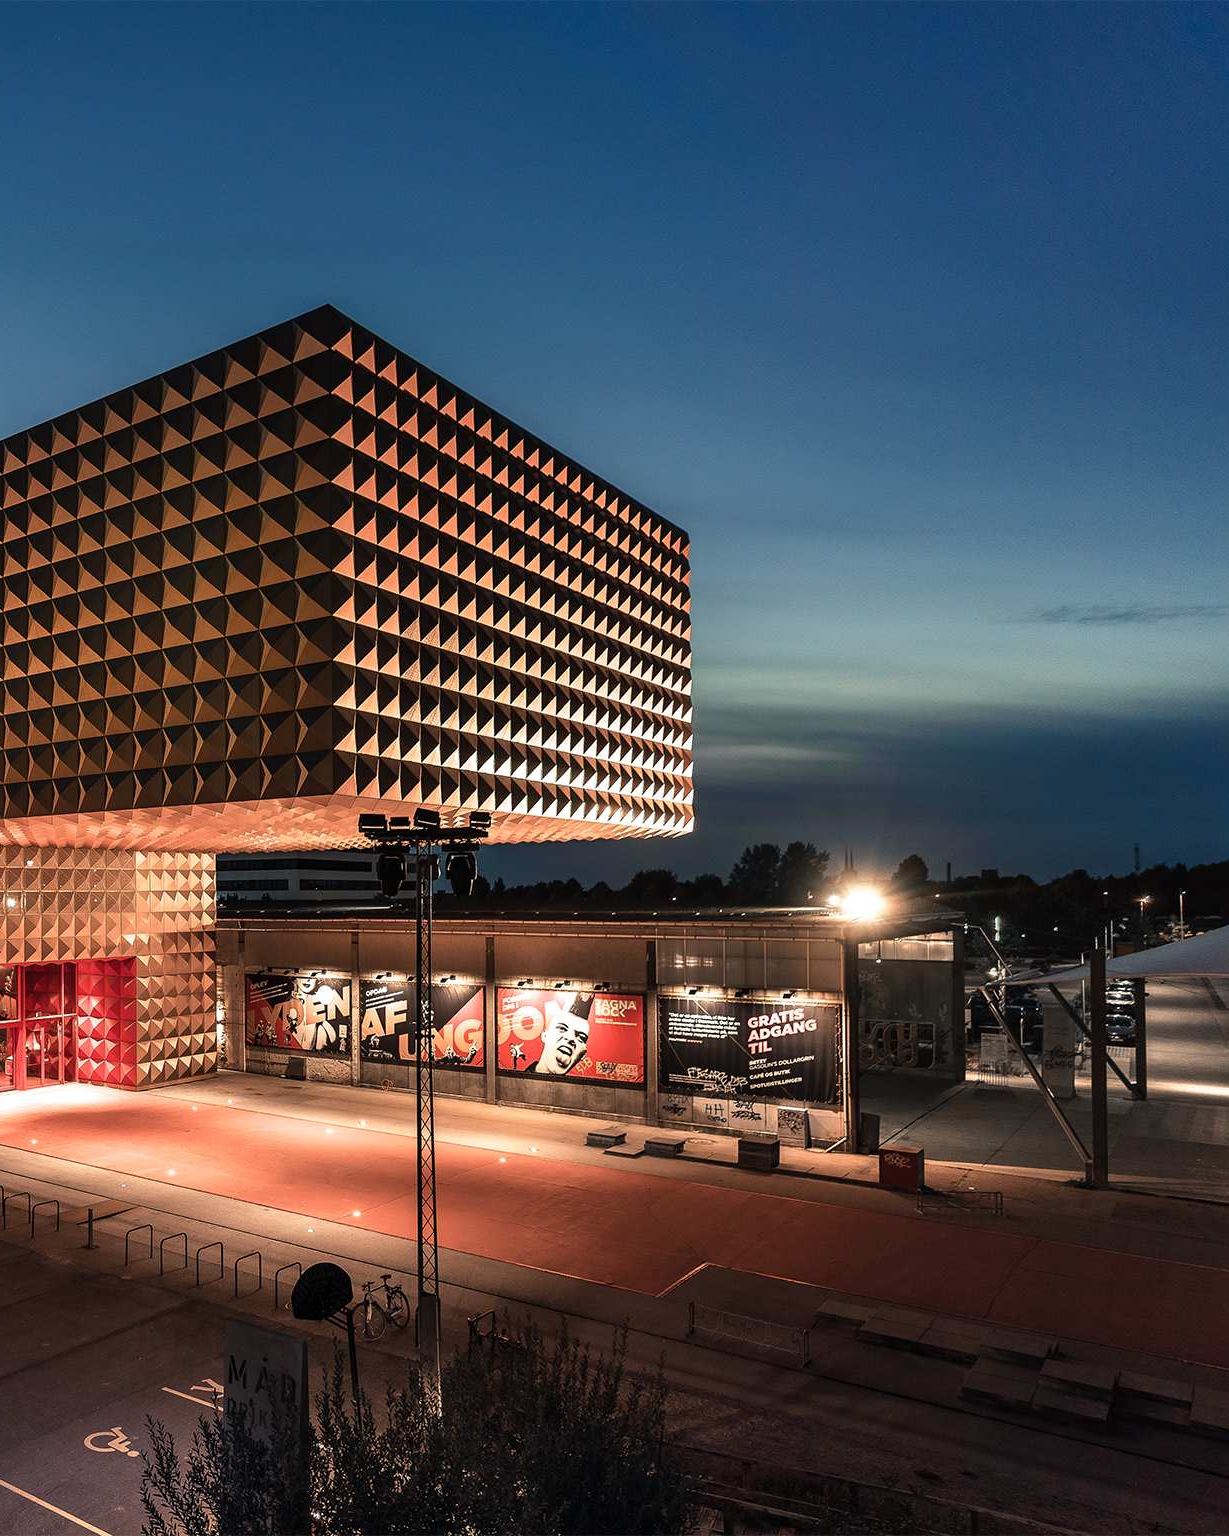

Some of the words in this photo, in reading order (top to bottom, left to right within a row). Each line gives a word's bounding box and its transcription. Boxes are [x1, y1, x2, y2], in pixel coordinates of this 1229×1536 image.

[362, 999, 408, 1040] AF
[747, 1008, 805, 1029] GRATIS
[747, 1019, 818, 1042] ADGANG
[748, 1041, 773, 1055] TIL
